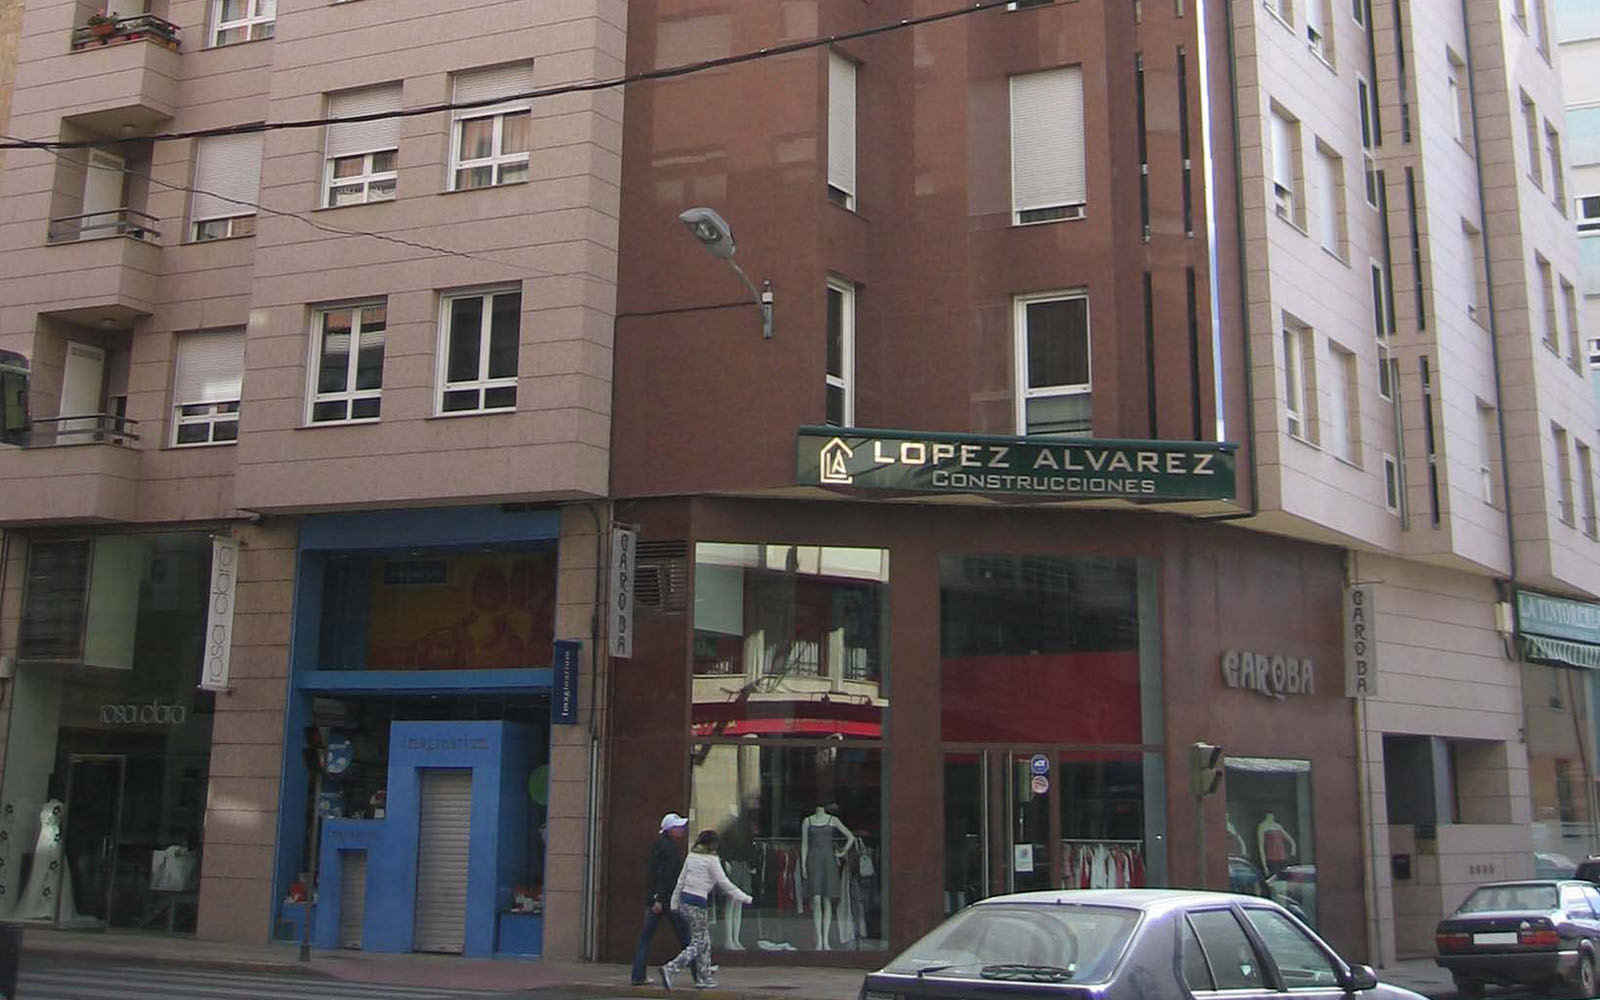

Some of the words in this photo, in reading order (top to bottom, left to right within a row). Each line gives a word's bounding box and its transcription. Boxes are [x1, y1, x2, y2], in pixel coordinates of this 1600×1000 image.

[873, 440, 1010, 468] LOPEZ
[1032, 448, 1215, 475] ALVAREZ
[932, 470, 1156, 494] CONSTRUCCIONES
[209, 623, 226, 682] rosa
